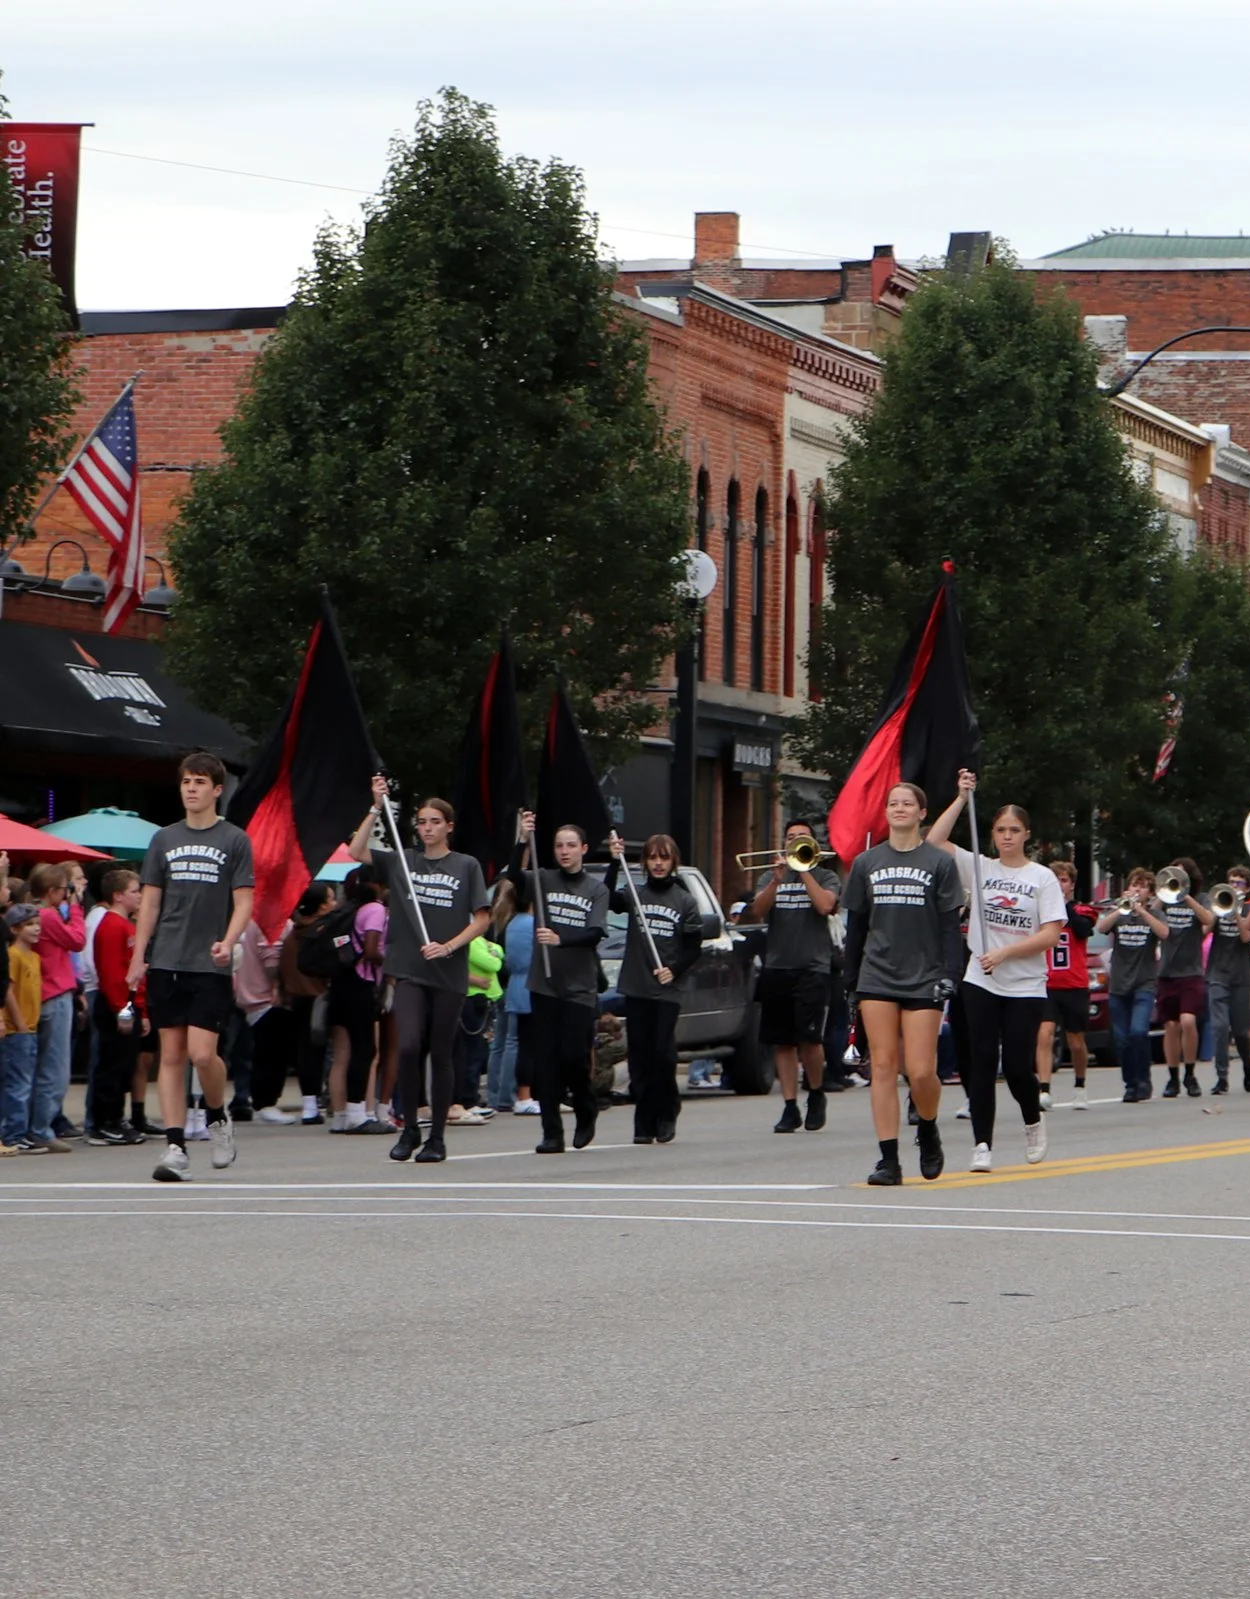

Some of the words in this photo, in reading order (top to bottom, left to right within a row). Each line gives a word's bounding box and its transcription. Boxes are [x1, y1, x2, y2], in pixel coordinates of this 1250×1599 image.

[165, 845, 228, 865] MARSHALL
[189, 861, 220, 874] SCHOOL
[869, 866, 933, 886] MARSHALL
[426, 887, 454, 899] SCHOOL
[872, 884, 893, 895] HIGH
[894, 884, 926, 896] SCHOOL
[981, 878, 1036, 899] MARSHALL
[561, 908, 586, 920] SCHOOL
[983, 909, 1033, 929] EDHAWKS
